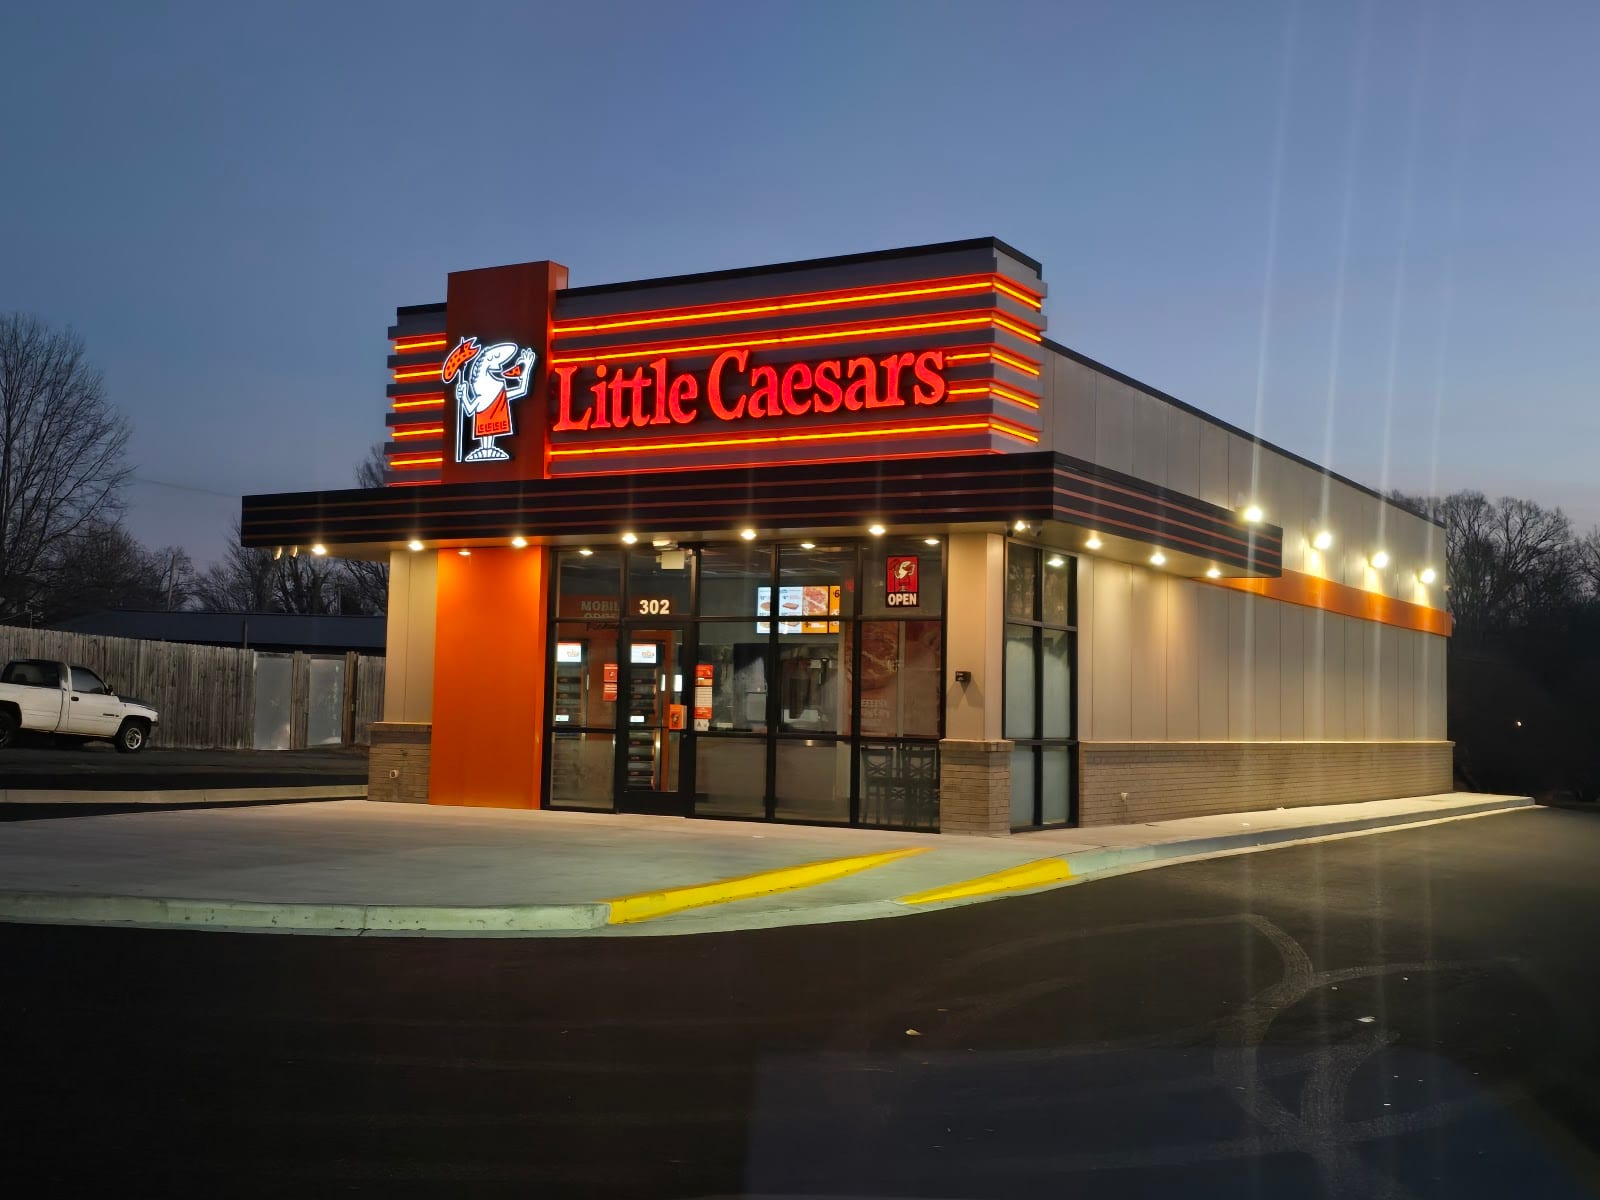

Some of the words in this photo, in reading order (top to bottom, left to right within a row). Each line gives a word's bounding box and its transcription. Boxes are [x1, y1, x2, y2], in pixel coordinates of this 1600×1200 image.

[552, 357, 698, 431] Little
[707, 349, 946, 420] Caesars
[581, 600, 620, 611] MOBIL
[887, 593, 917, 606] OPEN
[639, 599, 670, 615] 302
